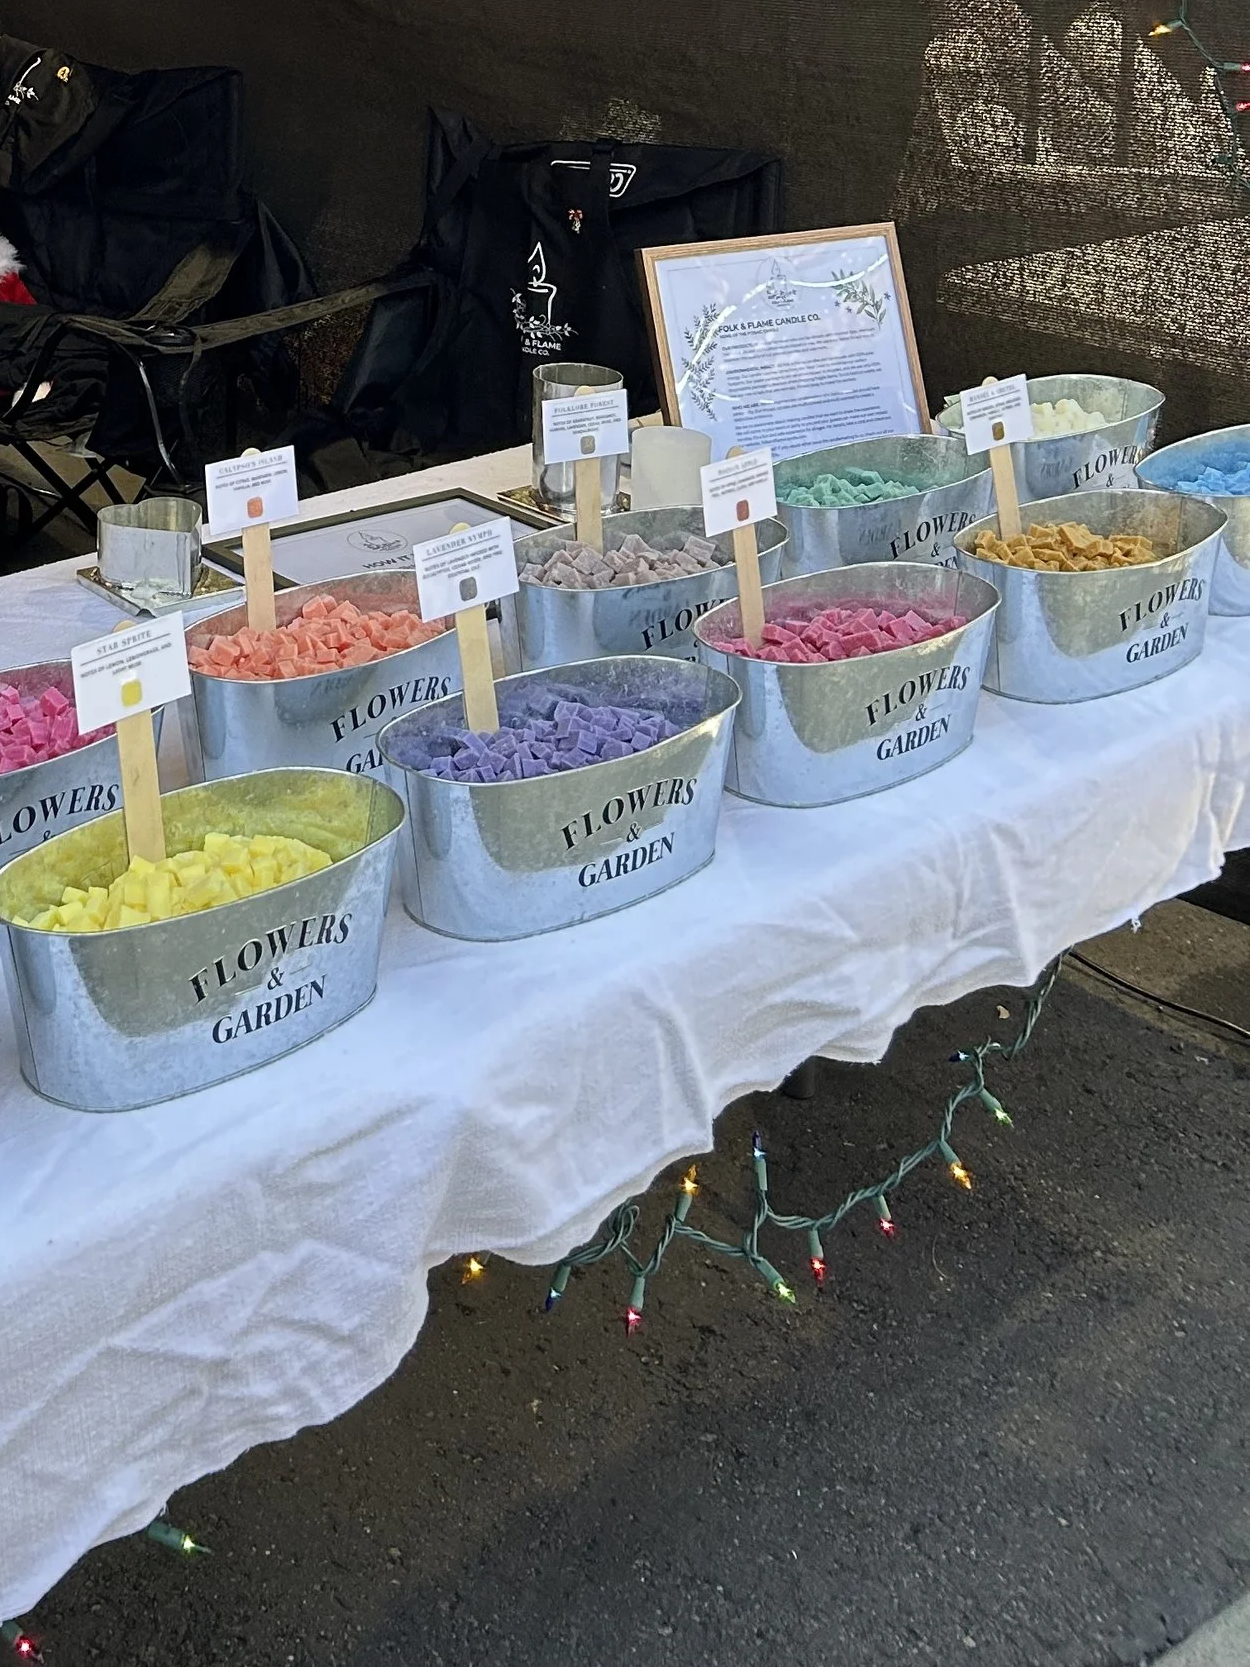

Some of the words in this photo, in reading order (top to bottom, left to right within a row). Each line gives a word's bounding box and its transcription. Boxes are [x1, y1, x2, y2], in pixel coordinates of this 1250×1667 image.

[718, 322, 740, 333] FOLK
[740, 322, 747, 330] &
[748, 319, 774, 329] FLAME
[776, 315, 806, 326] CANDLE
[807, 313, 821, 322] CO.
[524, 338, 530, 346] &
[532, 340, 562, 350] FLAME
[1106, 473, 1114, 488] &
[426, 538, 466, 556] LAVENDER
[468, 529, 493, 542] NYMPH
[930, 542, 940, 558] &
[362, 558, 397, 569] HOW
[397, 554, 411, 562] IT
[1118, 578, 1206, 632] FLOWERS
[1160, 612, 1170, 628] &
[96, 642, 118, 655] STAR
[122, 630, 152, 646] SPRITE
[1126, 622, 1189, 663] GARDEN
[864, 665, 970, 726] FLOWERS
[330, 676, 451, 744] FLOWERS
[915, 703, 927, 722] &
[876, 714, 951, 760] GARDEN
[561, 778, 698, 850] FLOWERS
[626, 822, 642, 842] &
[578, 832, 675, 888] GARDEN
[188, 913, 353, 1004] FLOWERS
[267, 966, 285, 990] &
[212, 974, 327, 1044] GARDEN
